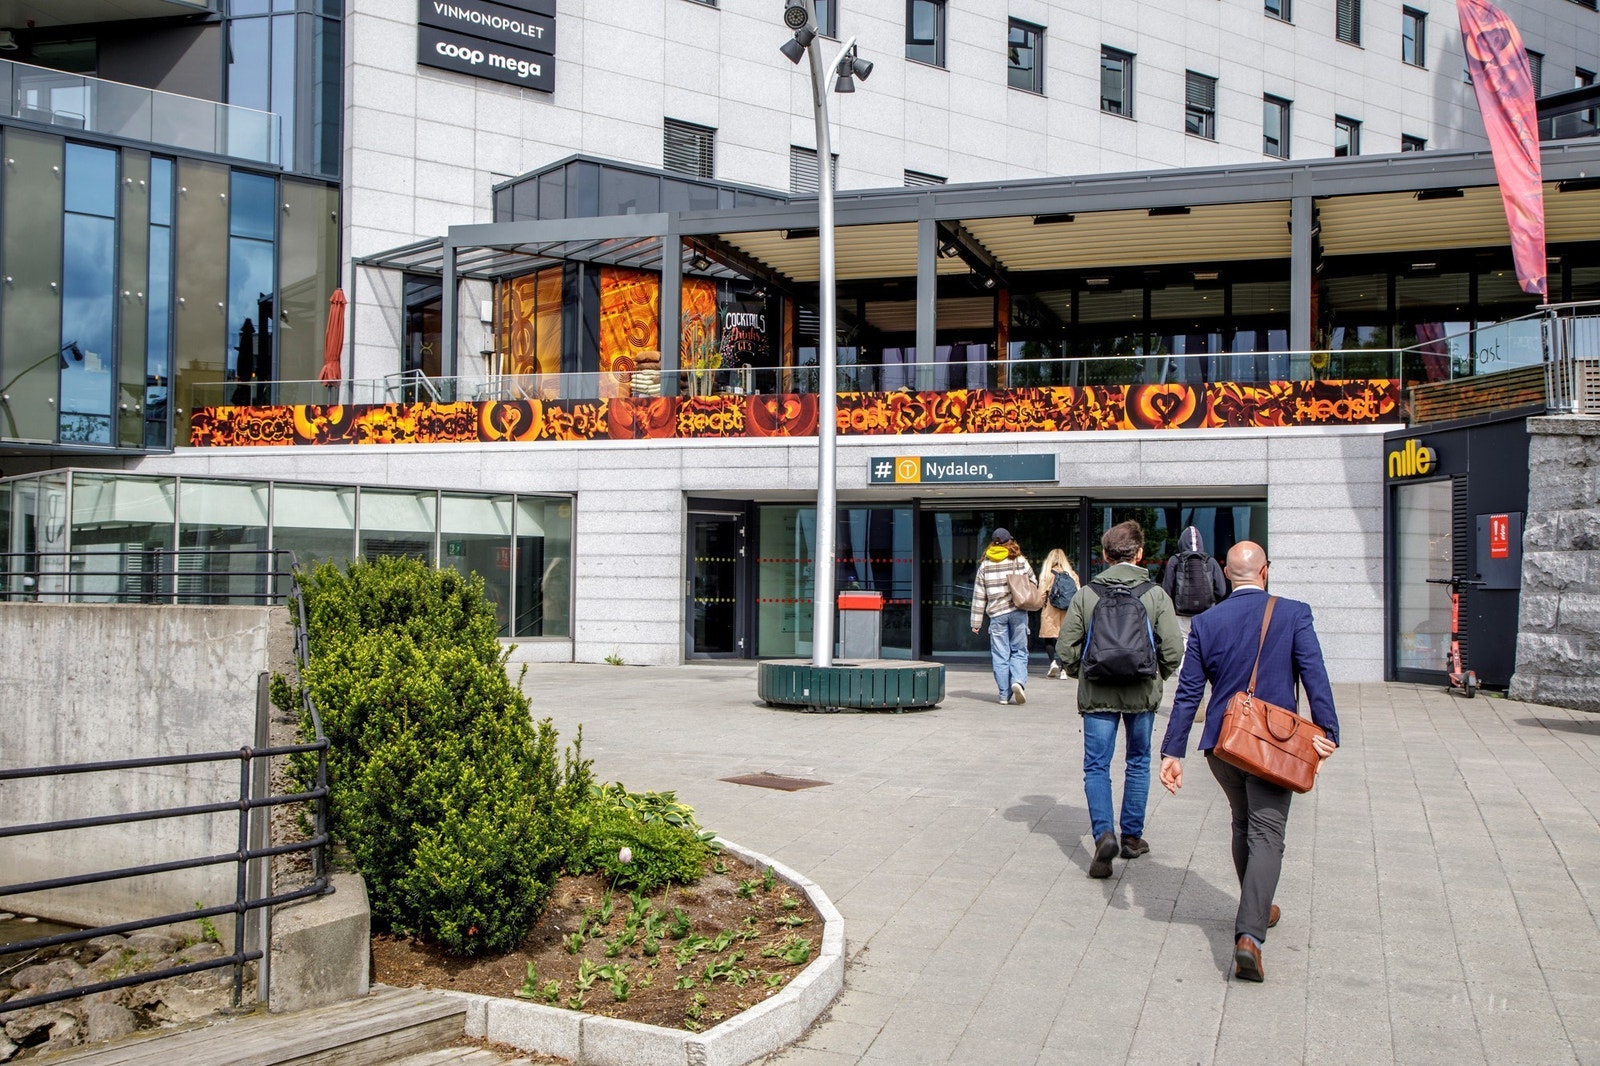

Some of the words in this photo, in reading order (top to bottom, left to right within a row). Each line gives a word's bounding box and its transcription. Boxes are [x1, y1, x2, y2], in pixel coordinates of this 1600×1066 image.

[433, 1, 544, 39] VINMONOPOLET
[435, 41, 484, 65] coop
[488, 53, 542, 78] mega
[725, 312, 766, 333] COCKTAILS
[1388, 438, 1432, 479] nille
